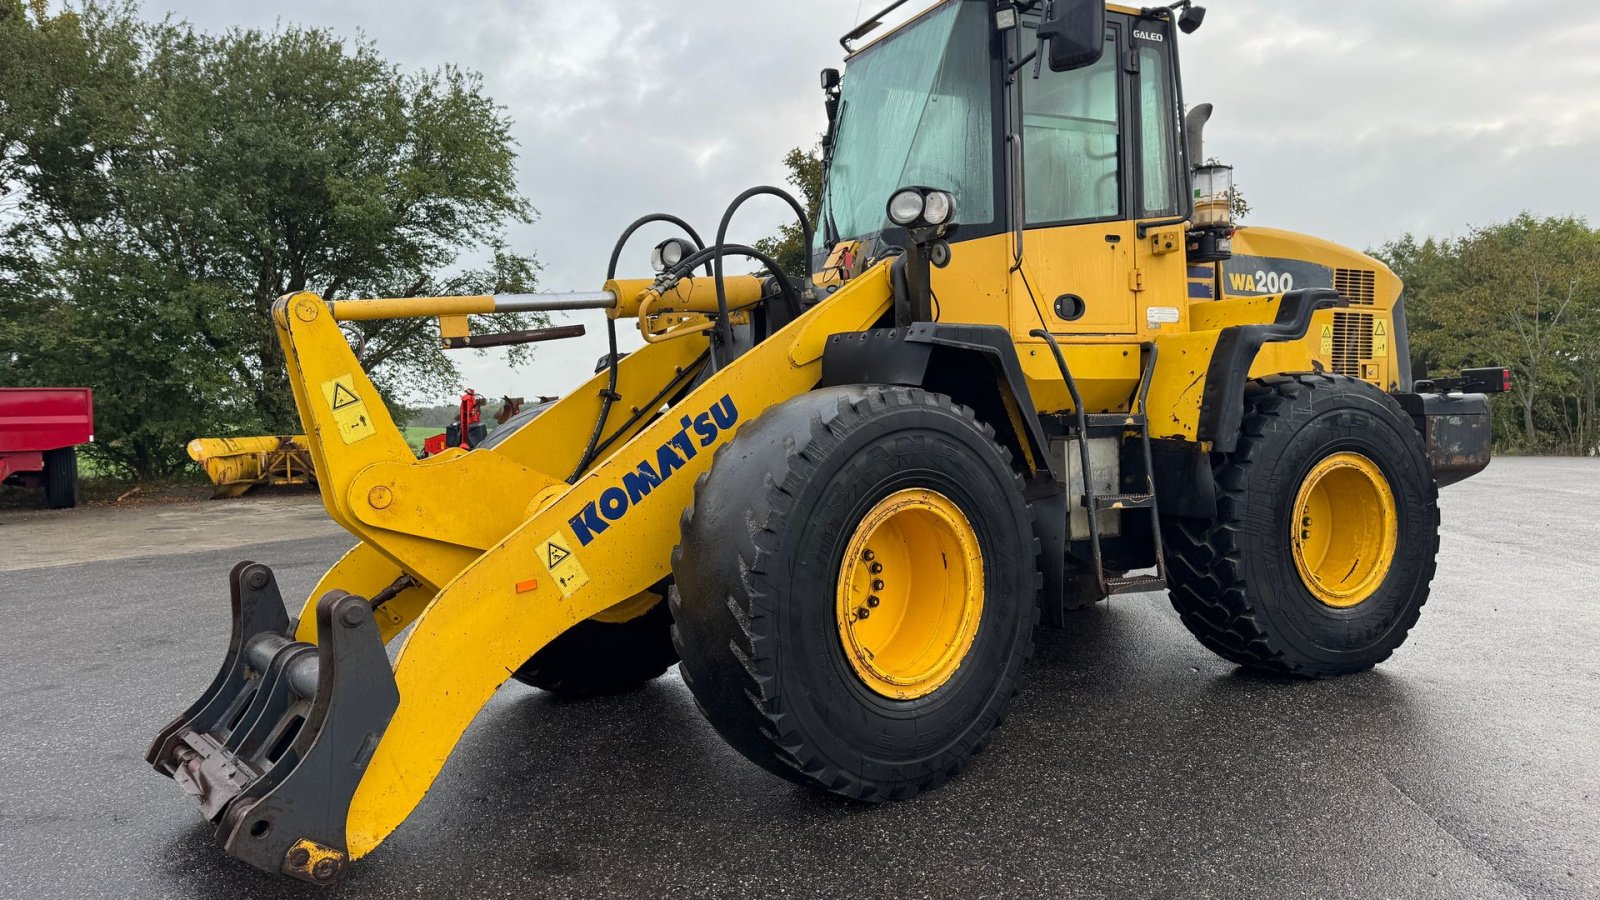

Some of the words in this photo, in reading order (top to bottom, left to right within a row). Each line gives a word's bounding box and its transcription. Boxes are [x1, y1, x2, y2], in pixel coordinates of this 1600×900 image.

[1133, 30, 1163, 42] GALEO
[1228, 270, 1293, 294] WA200
[567, 393, 739, 547] KOMATSU
